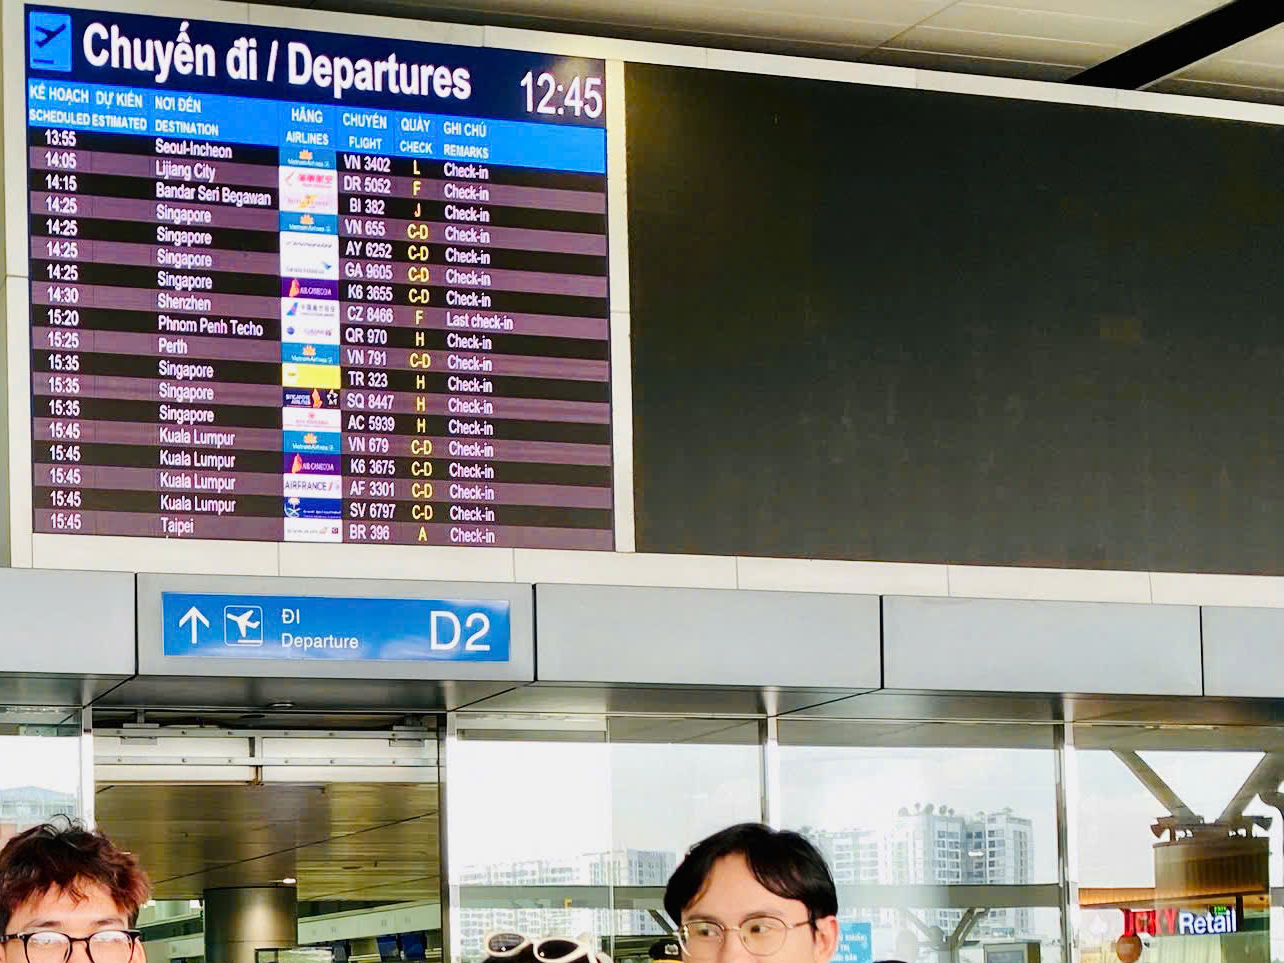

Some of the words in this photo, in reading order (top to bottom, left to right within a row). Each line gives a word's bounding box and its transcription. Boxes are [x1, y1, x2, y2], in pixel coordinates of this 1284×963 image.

[83, 20, 216, 83] Chuyến
[227, 37, 257, 80] đi
[288, 41, 471, 100] Departures
[520, 71, 602, 119] 12:45
[29, 108, 90, 126] SCHEDULED
[92, 112, 147, 131] ESTIMATED
[155, 120, 219, 136] DESTINATION
[443, 121, 461, 135] GHI
[464, 121, 487, 137] CHÚ
[45, 129, 76, 146] 13:55
[156, 138, 232, 158] Seoul-Incheon
[344, 154, 360, 169] VN
[364, 156, 390, 172] 3402
[444, 162, 488, 179] Check-in
[286, 130, 329, 145] AIRLINES
[349, 135, 382, 150] FLIGHT
[399, 140, 432, 154] CHECK
[443, 144, 489, 159] REMARKS
[45, 151, 76, 168] 14:05
[156, 160, 191, 181] Lijiang
[194, 163, 215, 182] City
[344, 176, 361, 191] DR
[364, 177, 391, 193] 5052
[444, 184, 489, 200] Check-in
[46, 174, 77, 191] 14:15
[156, 182, 196, 199] Bandar
[198, 185, 219, 201] Seri
[222, 187, 271, 207] Begawan
[350, 198, 361, 212] BI
[365, 199, 384, 214] 382
[445, 205, 490, 222] Check-in
[46, 196, 77, 214] 14:25
[156, 204, 212, 225] Singapore
[345, 219, 362, 234] VN
[365, 221, 385, 236] 655
[445, 226, 490, 243] Check-in
[46, 219, 77, 236] 14:25
[157, 226, 212, 247] Singapore
[346, 241, 362, 256] AY
[366, 242, 392, 258] 6252
[446, 248, 490, 264] Check-in
[47, 241, 78, 258] 14:25
[157, 248, 212, 269] Singapore
[345, 262, 363, 277] GA
[366, 264, 392, 279] 9605
[446, 269, 491, 286] Check-in
[47, 264, 78, 280] 14:25
[158, 271, 212, 291] Singapore
[348, 284, 363, 299] K6
[367, 285, 393, 301] 3655
[446, 290, 491, 307] Check-in
[48, 286, 78, 303] 14:30
[158, 293, 211, 311] Shenzhen
[348, 306, 363, 321] CZ
[367, 307, 393, 322] 8466
[447, 313, 471, 328] Last
[473, 314, 513, 331] check-in
[48, 309, 79, 326] 15:20
[158, 315, 197, 332] Phnom
[200, 318, 227, 334] Penh
[230, 320, 263, 336] Techo
[346, 328, 364, 342] QR
[367, 329, 387, 344] 970
[447, 333, 492, 349] Check-in
[48, 331, 79, 348] 15:25
[159, 338, 187, 354] Perth
[347, 349, 364, 364] VN
[368, 350, 386, 365] 791
[448, 355, 492, 371] Check-in
[48, 354, 79, 370] 15:35
[159, 360, 214, 380] Singapore
[348, 371, 364, 386] TR
[368, 372, 388, 387] 323
[448, 376, 492, 392] Check-in
[49, 377, 79, 394] 15:35
[159, 382, 214, 403] Singapore
[347, 393, 364, 408] SQ
[368, 394, 394, 409] 8447
[448, 398, 493, 414] Check-in
[49, 400, 80, 416] 15:35
[160, 405, 214, 425] Singapore
[348, 415, 364, 430] AC
[369, 416, 394, 431] 5939
[449, 419, 493, 435] Check-in
[50, 422, 80, 439] 15:45
[160, 427, 190, 444] Kuala
[194, 429, 235, 448] Lumpur
[348, 437, 365, 452] VN
[369, 438, 388, 452] 679
[449, 441, 493, 457] Check-in
[50, 445, 80, 461] 15:45
[160, 450, 191, 466] Kuala
[194, 451, 235, 470] Lumpur
[351, 459, 365, 473] K6
[370, 460, 395, 474] 3675
[449, 462, 494, 478] Check-in
[50, 468, 80, 484] 15:45
[160, 472, 191, 488] Kuala
[194, 473, 236, 493] Lumpur
[285, 481, 327, 491] AIRFRANCE
[350, 481, 365, 495] AF
[370, 481, 394, 496] 3301
[450, 484, 494, 500] Check-in
[50, 491, 81, 507] 15:45
[161, 495, 191, 510] Kuala
[195, 496, 236, 515] Lumpur
[350, 502, 366, 517] SV
[370, 503, 396, 518] 6797
[450, 506, 494, 521] Check-in
[51, 513, 81, 529] 15:45
[161, 517, 193, 536] Taipei
[350, 524, 366, 539] BR
[370, 525, 389, 540] 396
[281, 608, 301, 624] ĐI
[430, 610, 491, 651] D2
[281, 632, 359, 651] Departure
[1178, 906, 1237, 935] Retail
